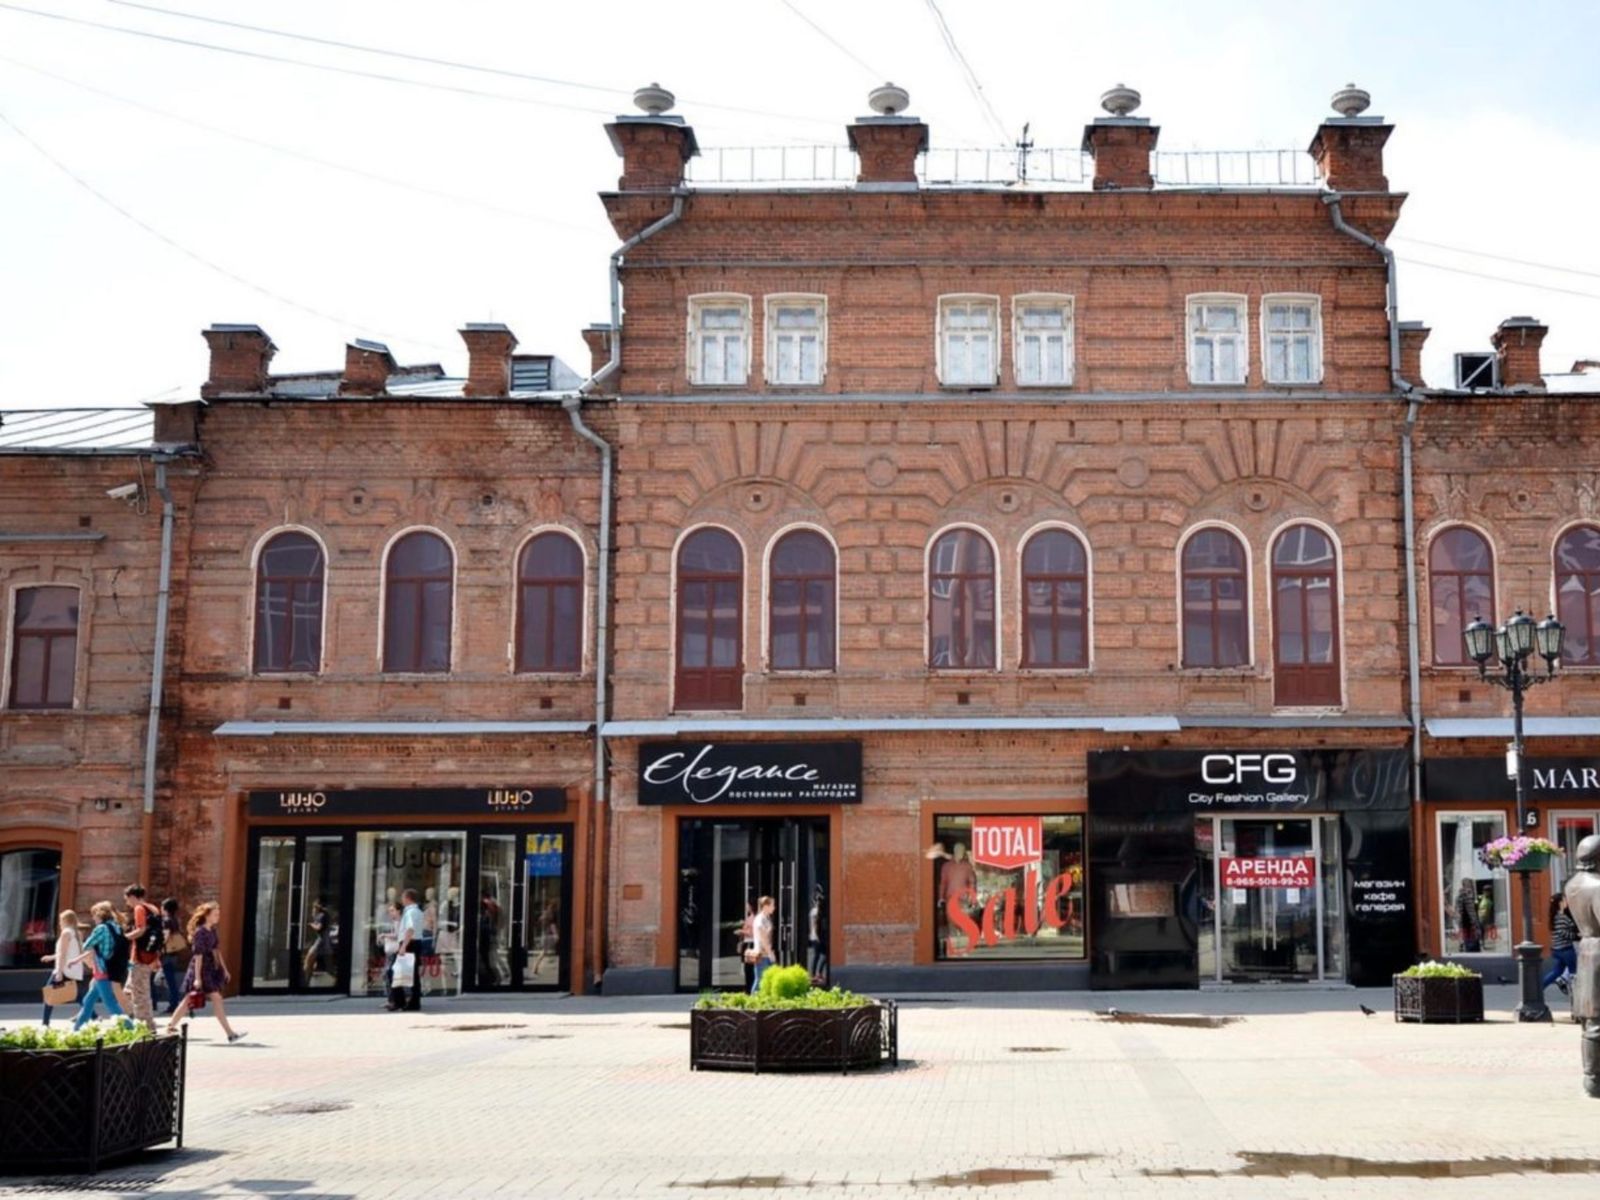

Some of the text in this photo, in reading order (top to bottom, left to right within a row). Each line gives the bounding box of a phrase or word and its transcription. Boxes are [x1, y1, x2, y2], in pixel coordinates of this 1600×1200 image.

[644, 745, 820, 802] Elegance
[1201, 754, 1296, 784] CFG
[1533, 768, 1600, 789] MAR
[729, 791, 793, 799] ПОСТОЯННЫХ
[1188, 792, 1309, 805] City Fashion Gallery
[974, 827, 1041, 857] TOTAL
[1226, 860, 1309, 876] АРЕНДА
[1354, 880, 1405, 888] магазин
[1363, 892, 1396, 902] кафе
[946, 870, 1074, 958] Sale
[1355, 903, 1405, 913] галерея
